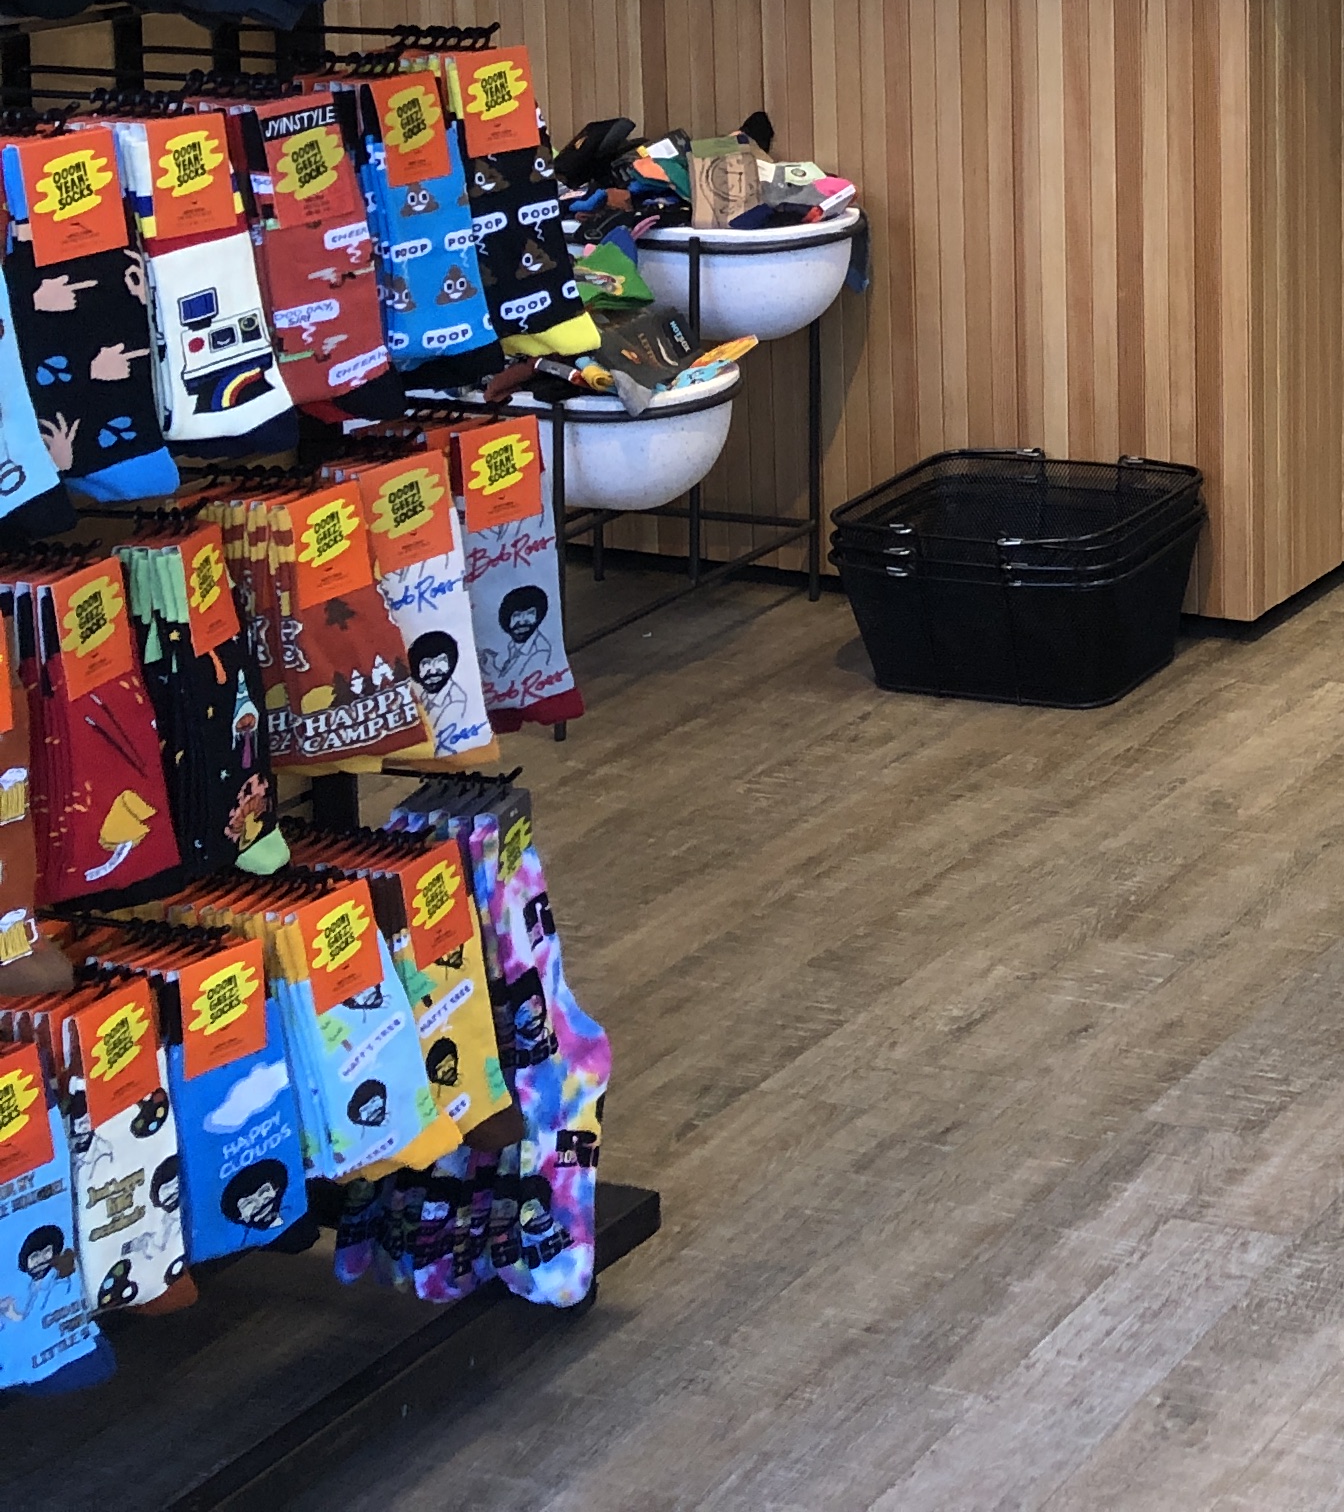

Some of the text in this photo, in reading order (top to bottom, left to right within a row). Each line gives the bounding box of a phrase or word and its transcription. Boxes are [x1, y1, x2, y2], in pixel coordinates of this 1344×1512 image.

[485, 90, 512, 112] SOCKS
[265, 106, 336, 137] JYINSTYLE
[173, 141, 203, 161] OOOH!
[53, 161, 88, 183] OOOH!
[175, 154, 203, 175] YEAH!
[177, 164, 206, 187] SOCKS
[298, 161, 328, 189] SOCKS
[56, 175, 89, 197] YEAH!
[58, 184, 93, 210] SOCKS
[472, 218, 503, 232] OOP
[522, 205, 558, 221] POOP
[448, 234, 479, 246] POO
[505, 297, 548, 315] POOP
[427, 329, 469, 345] POOP
[488, 464, 518, 486] SOCKS
[388, 480, 421, 504] OOOH!
[391, 493, 422, 517] GEEZ!
[393, 503, 425, 529] SOCKS
[316, 534, 344, 558] SOCKS
[464, 534, 556, 582] Bob Ross
[519, 668, 569, 706] Ross
[305, 682, 413, 736] HAPPY
[435, 722, 488, 756] Ross
[223, 1111, 282, 1160] HAPPY
[219, 1127, 292, 1179] CLOUDS
